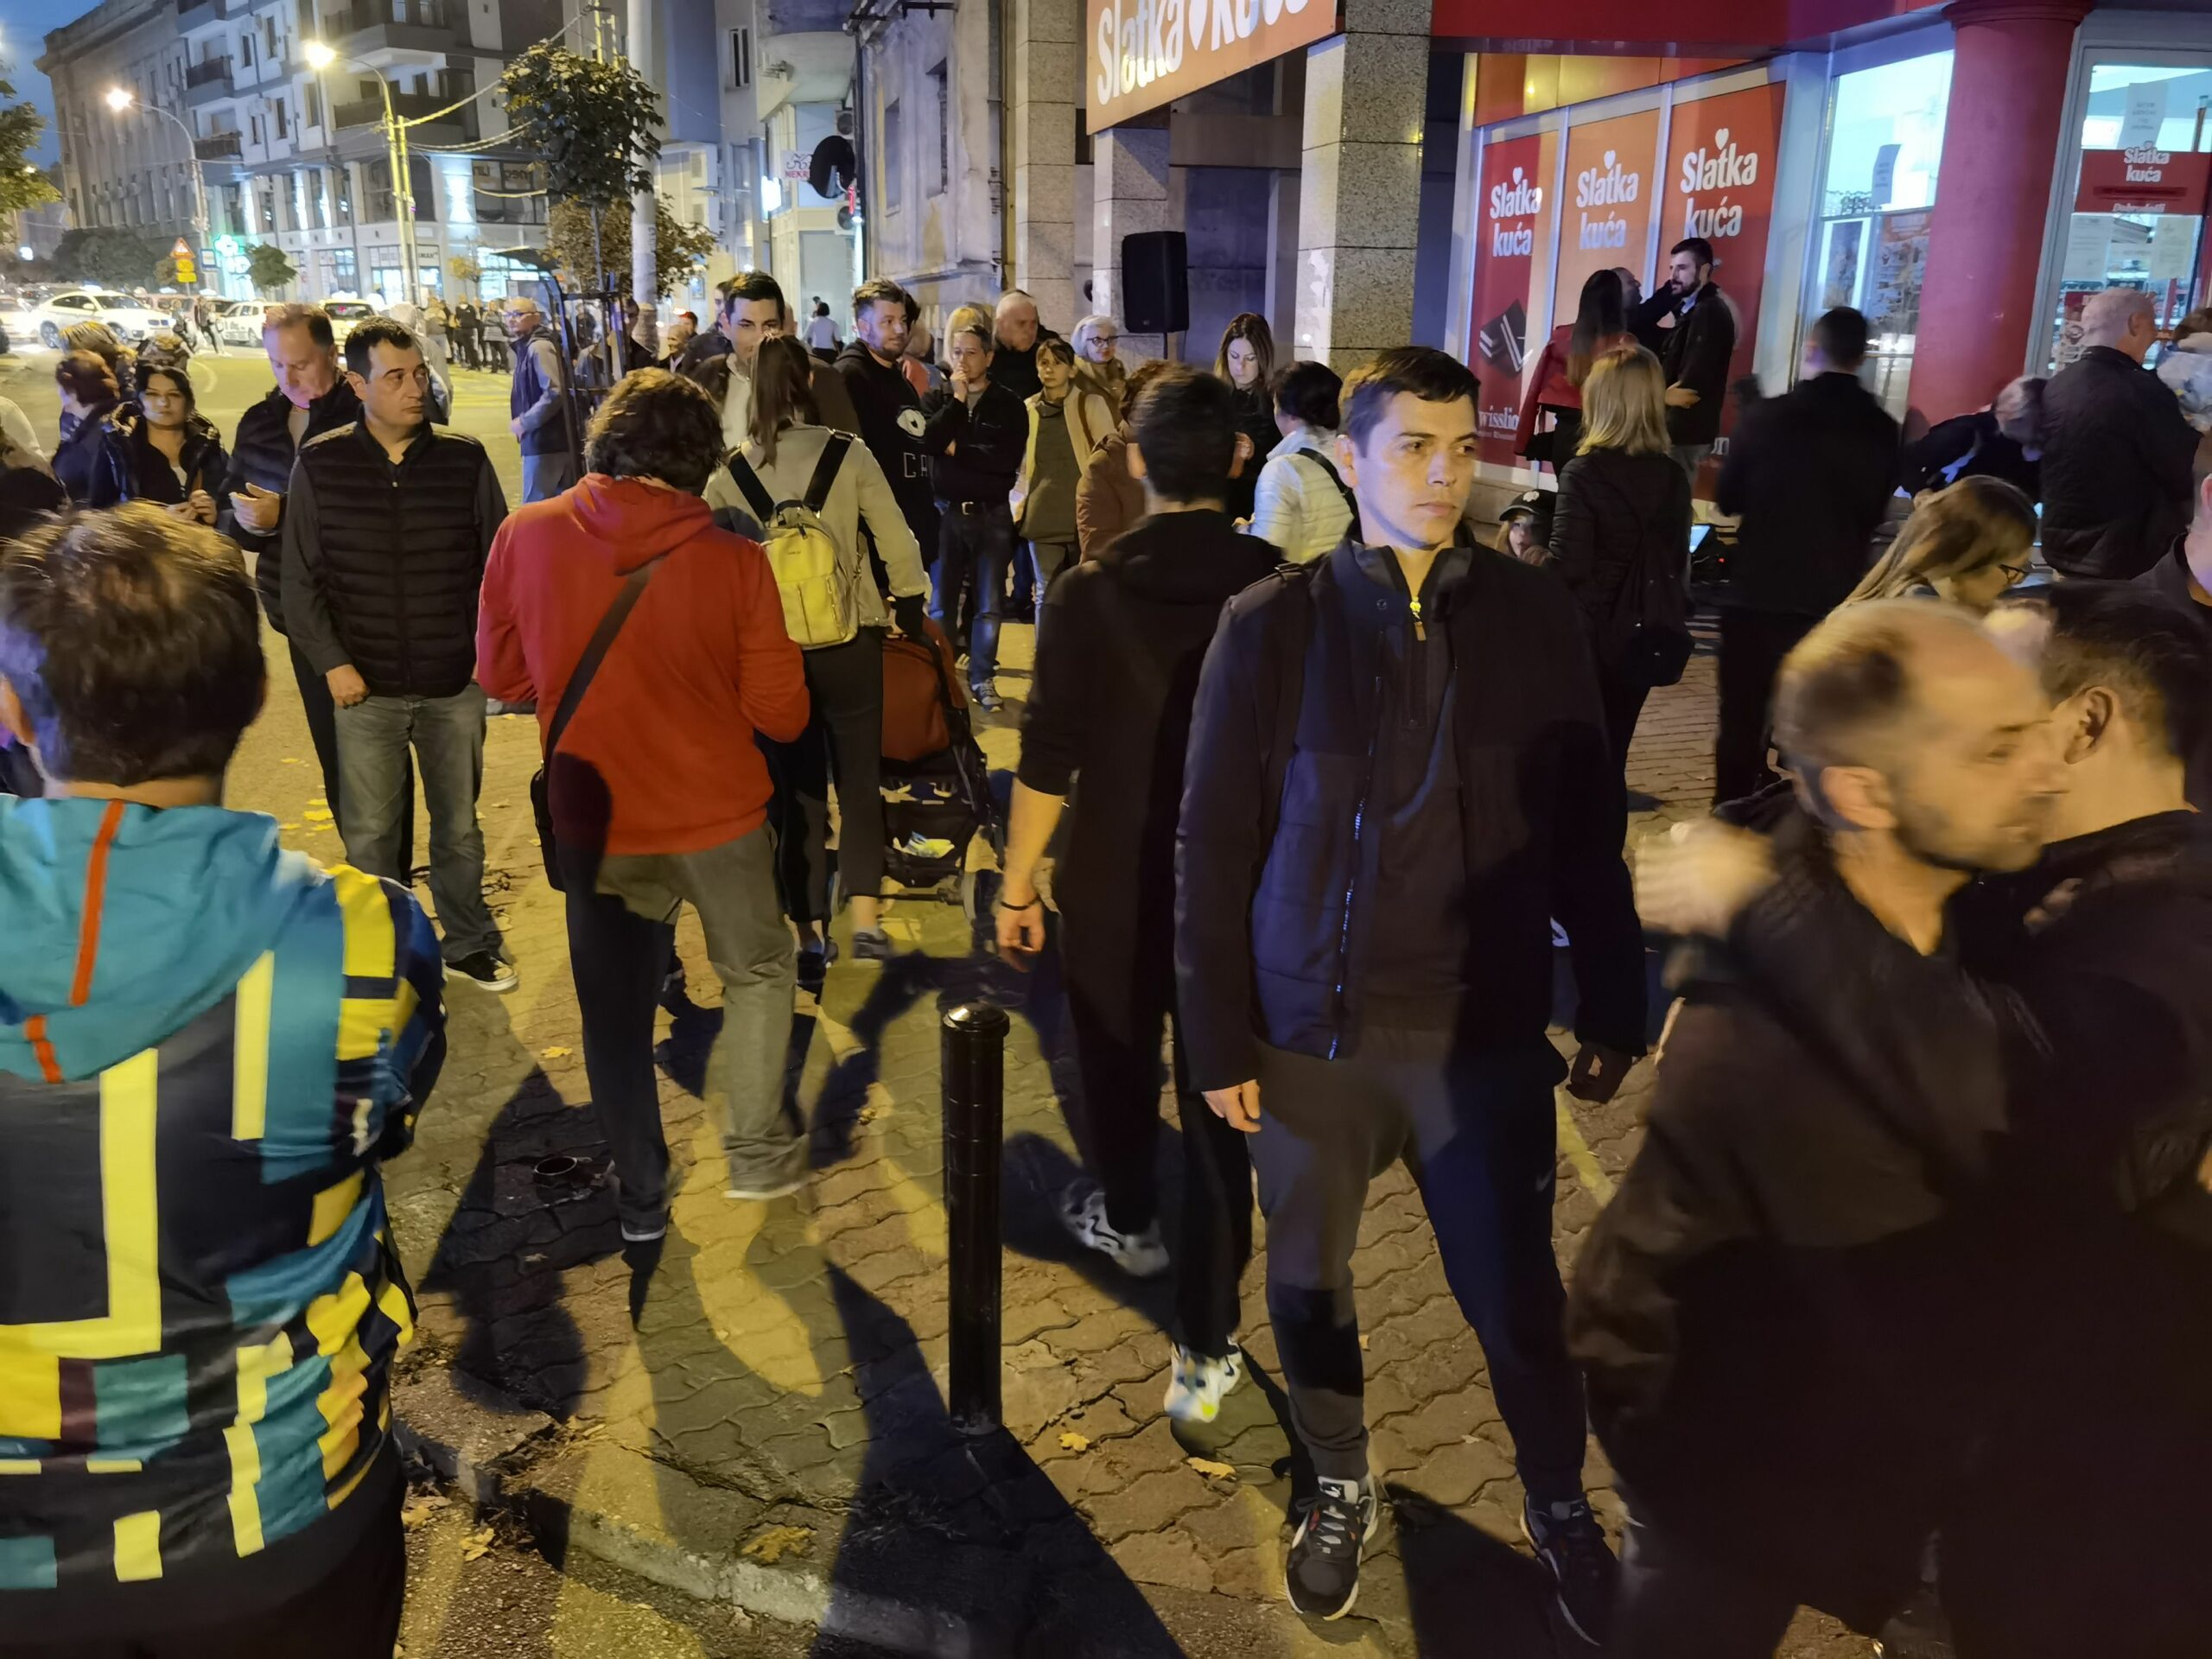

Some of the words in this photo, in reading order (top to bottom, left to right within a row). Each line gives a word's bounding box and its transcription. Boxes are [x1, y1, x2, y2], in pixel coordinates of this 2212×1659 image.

[1096, 0, 1184, 105] Slatka
[785, 170, 810, 179] NEKR
[1680, 143, 1758, 194] Slatka
[2124, 147, 2171, 164] Slatka
[2126, 165, 2162, 182] kuća
[1490, 180, 1543, 219] Slatka
[1576, 163, 1638, 207] Slatka
[1579, 211, 1627, 250] kuća
[1684, 196, 1743, 239] kuća
[1492, 221, 1532, 257] kuća
